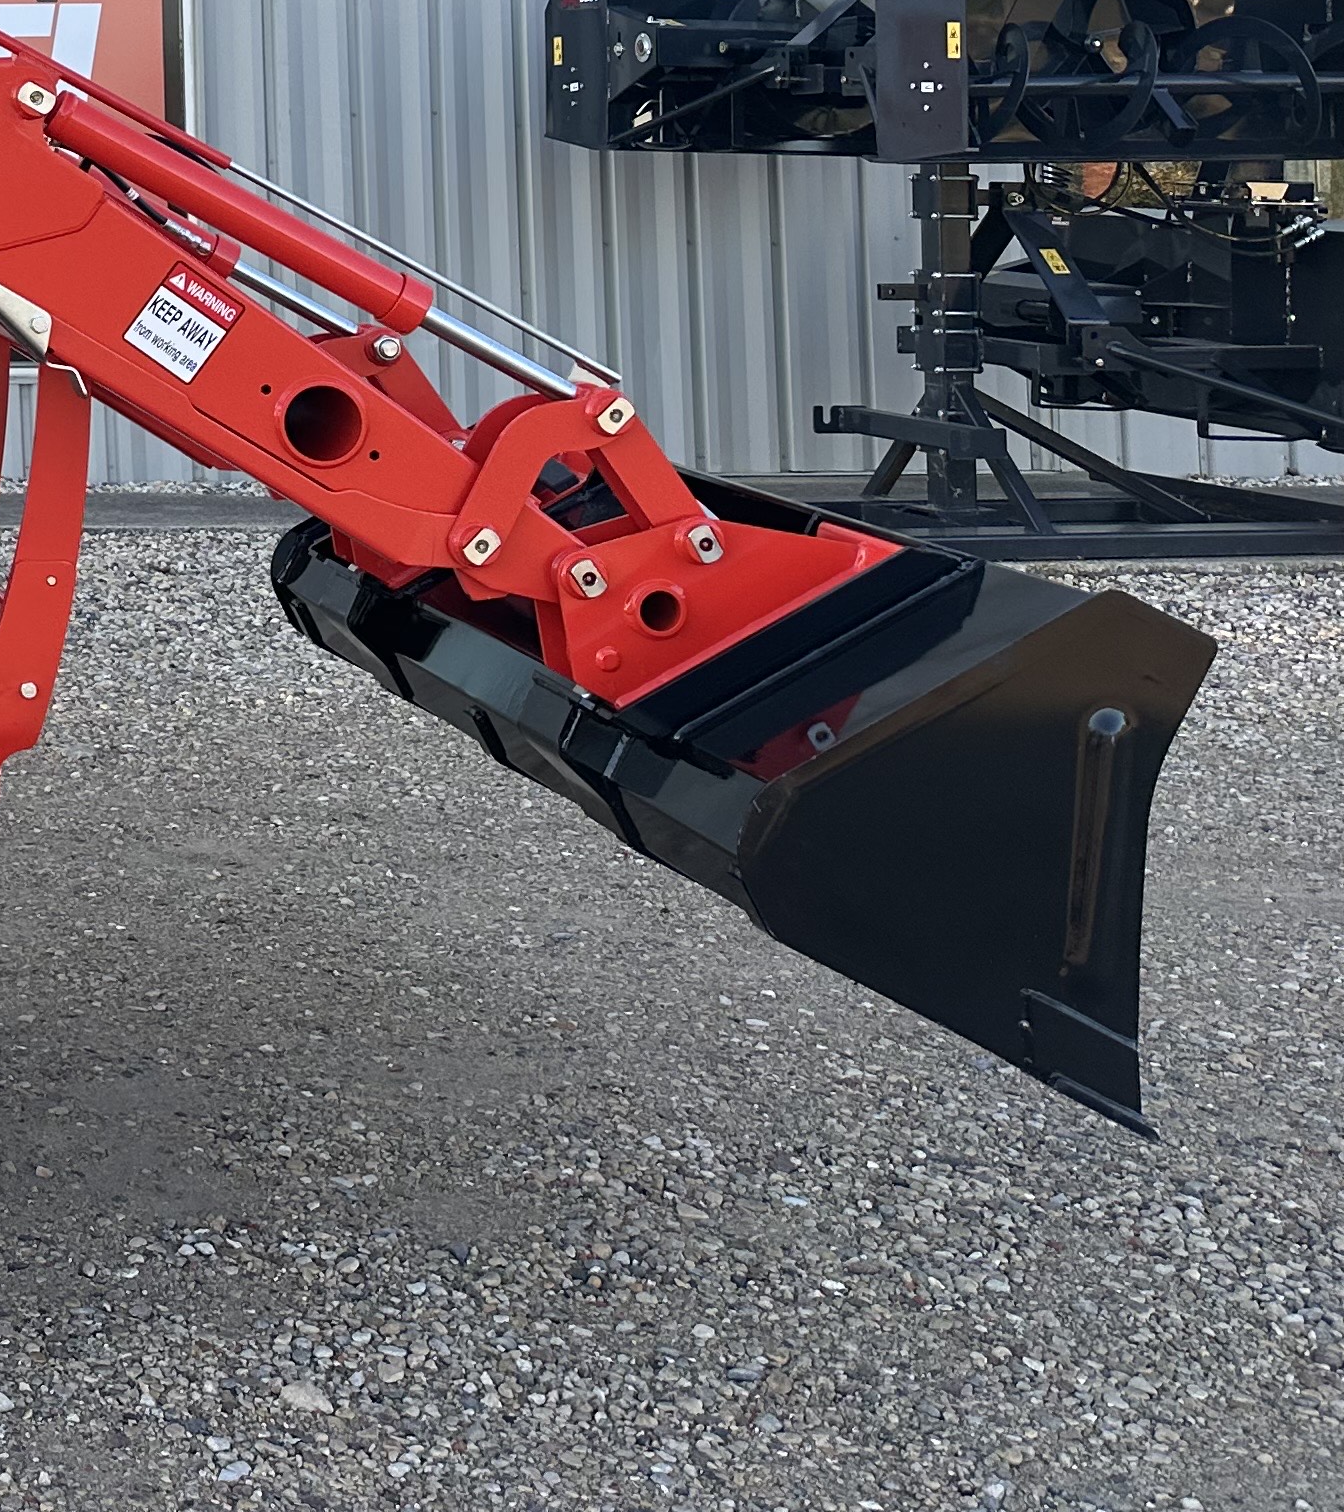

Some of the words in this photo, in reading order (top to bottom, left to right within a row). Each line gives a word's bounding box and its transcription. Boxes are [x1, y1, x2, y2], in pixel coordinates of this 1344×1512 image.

[147, 294, 183, 326] KEEP
[177, 317, 219, 351] AWAY
[186, 279, 237, 323] WARNING
[133, 319, 153, 340] from
[150, 333, 182, 363] working
[178, 354, 198, 372] area
